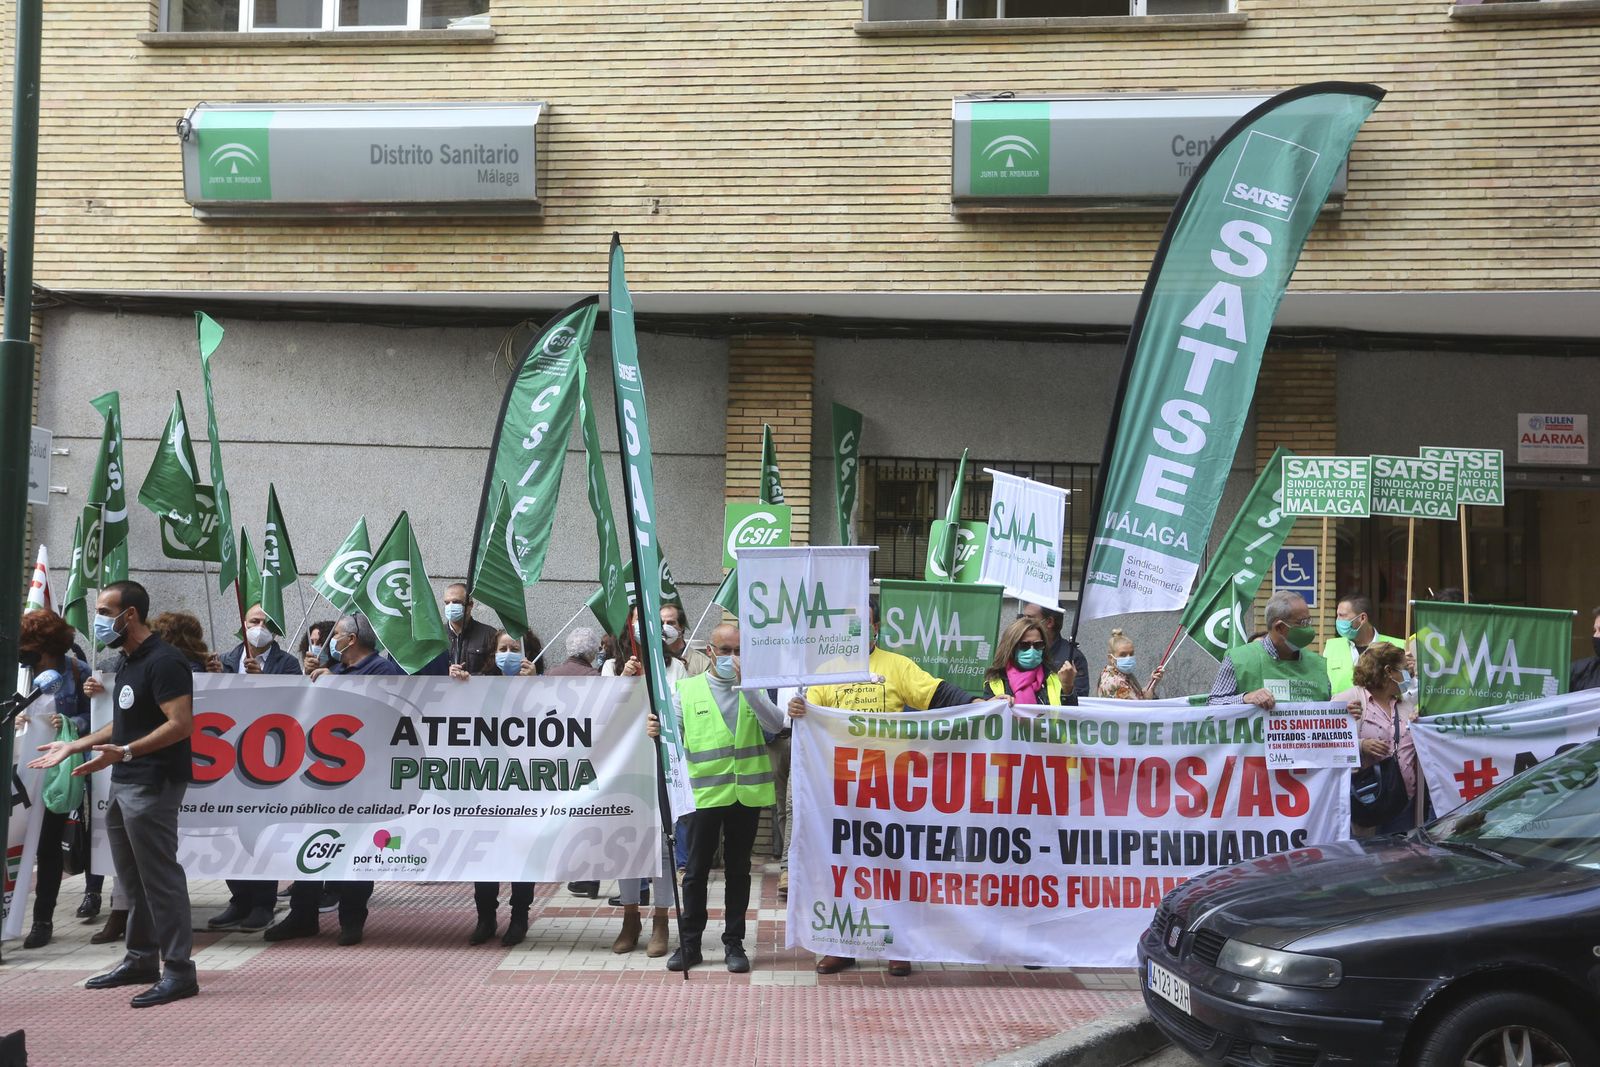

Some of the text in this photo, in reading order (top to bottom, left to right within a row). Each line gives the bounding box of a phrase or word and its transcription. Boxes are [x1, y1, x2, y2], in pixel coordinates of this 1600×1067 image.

[370, 143, 519, 165] Distrito Sanitario
[477, 169, 520, 186] Málaga
[980, 170, 998, 178] JUNTA
[1000, 170, 1008, 178] DE
[1232, 182, 1293, 212] SATSE
[1135, 219, 1274, 517] SATSE
[1545, 416, 1574, 424] EULEN
[1521, 433, 1585, 444] ALARMA
[1287, 460, 1368, 480] SATSE
[1374, 459, 1457, 482] SATSE
[1484, 472, 1499, 480] DE
[1287, 480, 1367, 489] SINDICATO DE
[1373, 478, 1454, 492] SINDICATO DE
[1287, 489, 1366, 499] ENFERMERIA
[1373, 488, 1454, 501] ENFERMERIA
[1286, 499, 1366, 514] MALAGA
[1372, 497, 1453, 517] MALAGA
[738, 526, 783, 546] CSIF
[1104, 510, 1190, 552] MÁLAGA
[1126, 555, 1165, 575] Sindicato
[1122, 578, 1154, 596] Málaga
[1124, 567, 1184, 594] de Enfermería
[748, 576, 857, 635] SMA
[884, 604, 985, 655] SMA
[751, 636, 790, 646] Sindicato
[818, 633, 852, 643] Andaluz
[817, 643, 860, 657] Málaga
[1423, 629, 1552, 688] SMA
[947, 664, 986, 677] Málaga
[855, 696, 878, 705] Salud
[1425, 684, 1466, 696] Sindicato
[1468, 687, 1503, 699] Médico
[1270, 709, 1298, 717] SINDICATO
[1299, 708, 1321, 716] MÉDICO
[390, 709, 593, 748] ATENCIÓN
[847, 713, 1003, 742] SINDICATO
[1128, 721, 1164, 746] DE
[1269, 718, 1349, 731] LOS SANITARIOS
[1267, 732, 1306, 742] PUTEADOS
[1311, 731, 1353, 741] APALEADOS
[1272, 742, 1282, 750] SIN
[1311, 741, 1355, 749] FUNDAMENTALES
[190, 712, 366, 787] SOS
[1269, 753, 1294, 764] SMA
[390, 757, 601, 791] PRIMARIA
[833, 746, 1311, 818] FACULTATIVOS/AS
[199, 800, 216, 814] de
[217, 802, 233, 814] un
[236, 801, 289, 815] servicio
[290, 801, 338, 817] público
[338, 802, 355, 815] de
[356, 802, 405, 816] calidad.
[407, 803, 431, 816] Por
[432, 803, 451, 816] los
[453, 803, 538, 818] profesionales
[540, 806, 547, 818] y
[549, 804, 567, 817] los
[568, 803, 635, 818] pacientes.
[831, 817, 1032, 865] PISOTEADOS
[1038, 844, 1051, 854] -
[353, 854, 428, 866] por ti, contigo
[831, 864, 848, 898] Y
[853, 866, 901, 901] SIN
[908, 868, 1059, 909] DERECHOS
[811, 900, 890, 938] SMA
[1152, 964, 1191, 1012] 4123 BXH
